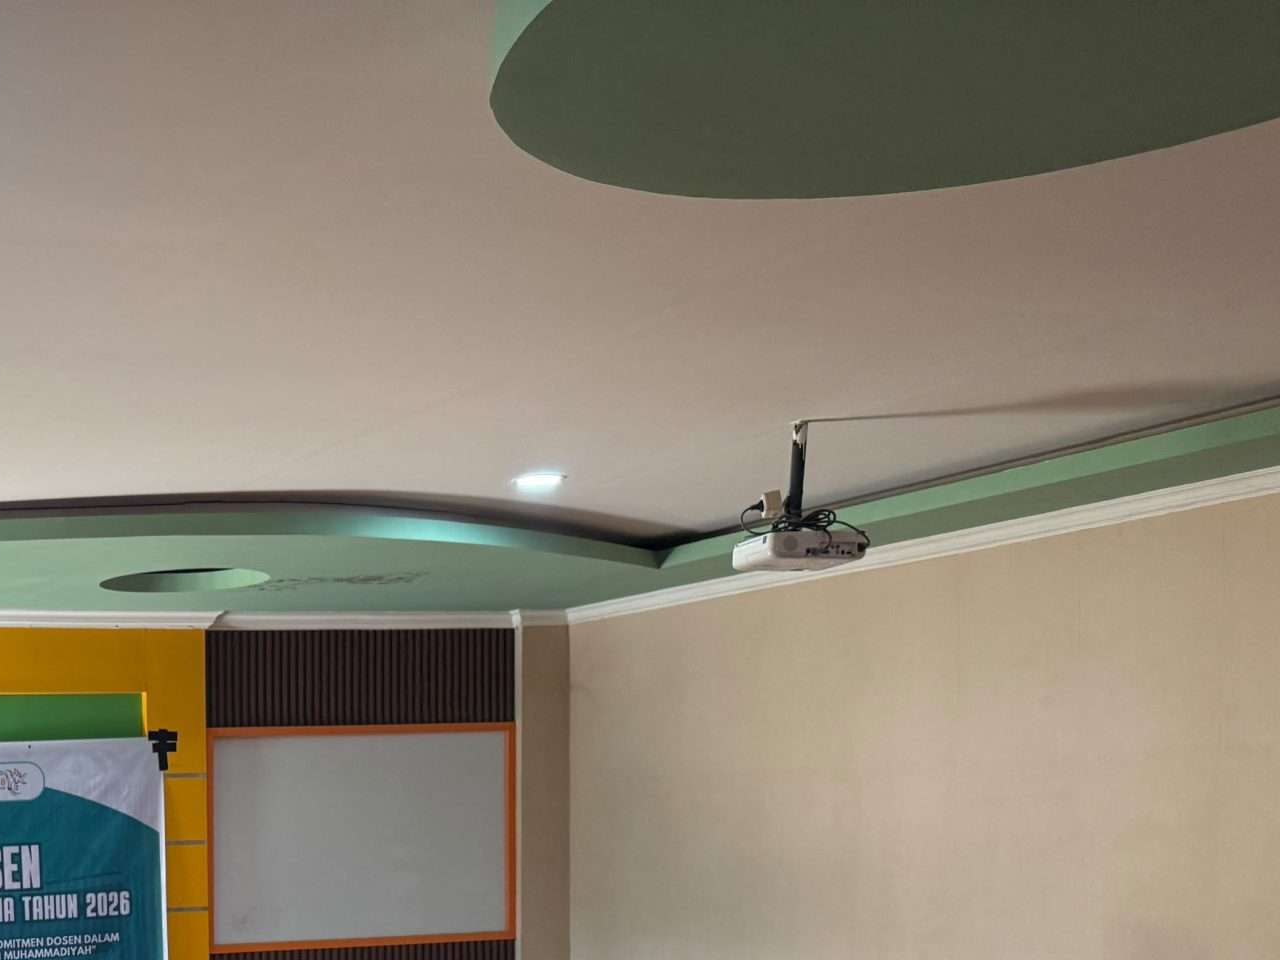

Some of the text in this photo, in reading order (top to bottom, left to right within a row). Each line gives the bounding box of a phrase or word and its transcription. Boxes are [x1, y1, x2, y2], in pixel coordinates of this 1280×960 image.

[22, 893, 78, 921] TAHUN
[86, 891, 130, 918] 2026
[46, 934, 82, 946] DOSEN
[84, 932, 120, 944] DALAM
[3, 945, 97, 960] MUHAMMADIYAH"
